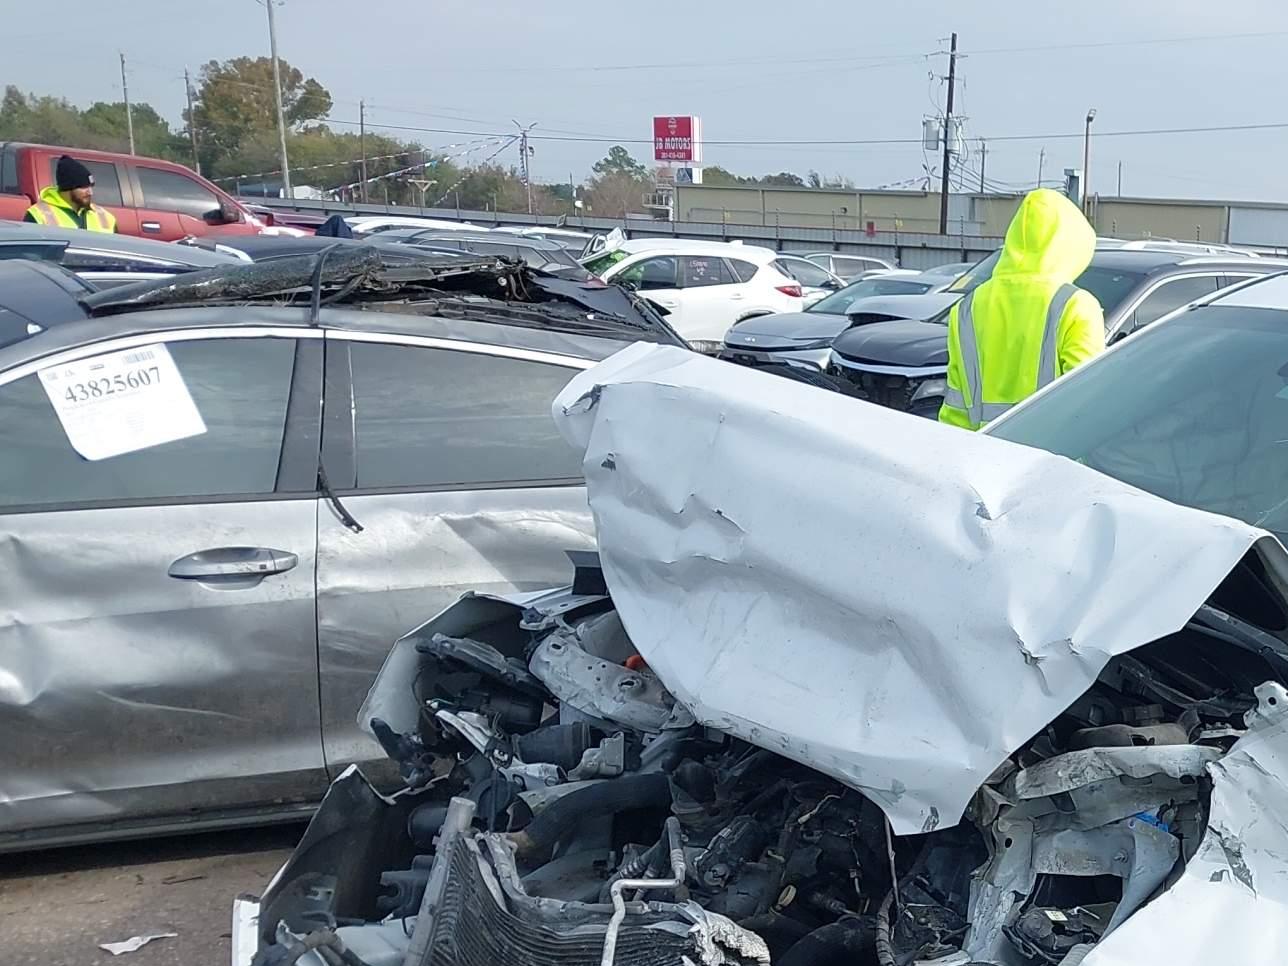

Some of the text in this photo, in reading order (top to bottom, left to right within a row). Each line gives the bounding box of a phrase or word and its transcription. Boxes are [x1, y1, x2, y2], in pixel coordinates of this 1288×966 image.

[656, 137, 691, 150] JB MOTORS
[64, 366, 162, 403] 43825607
